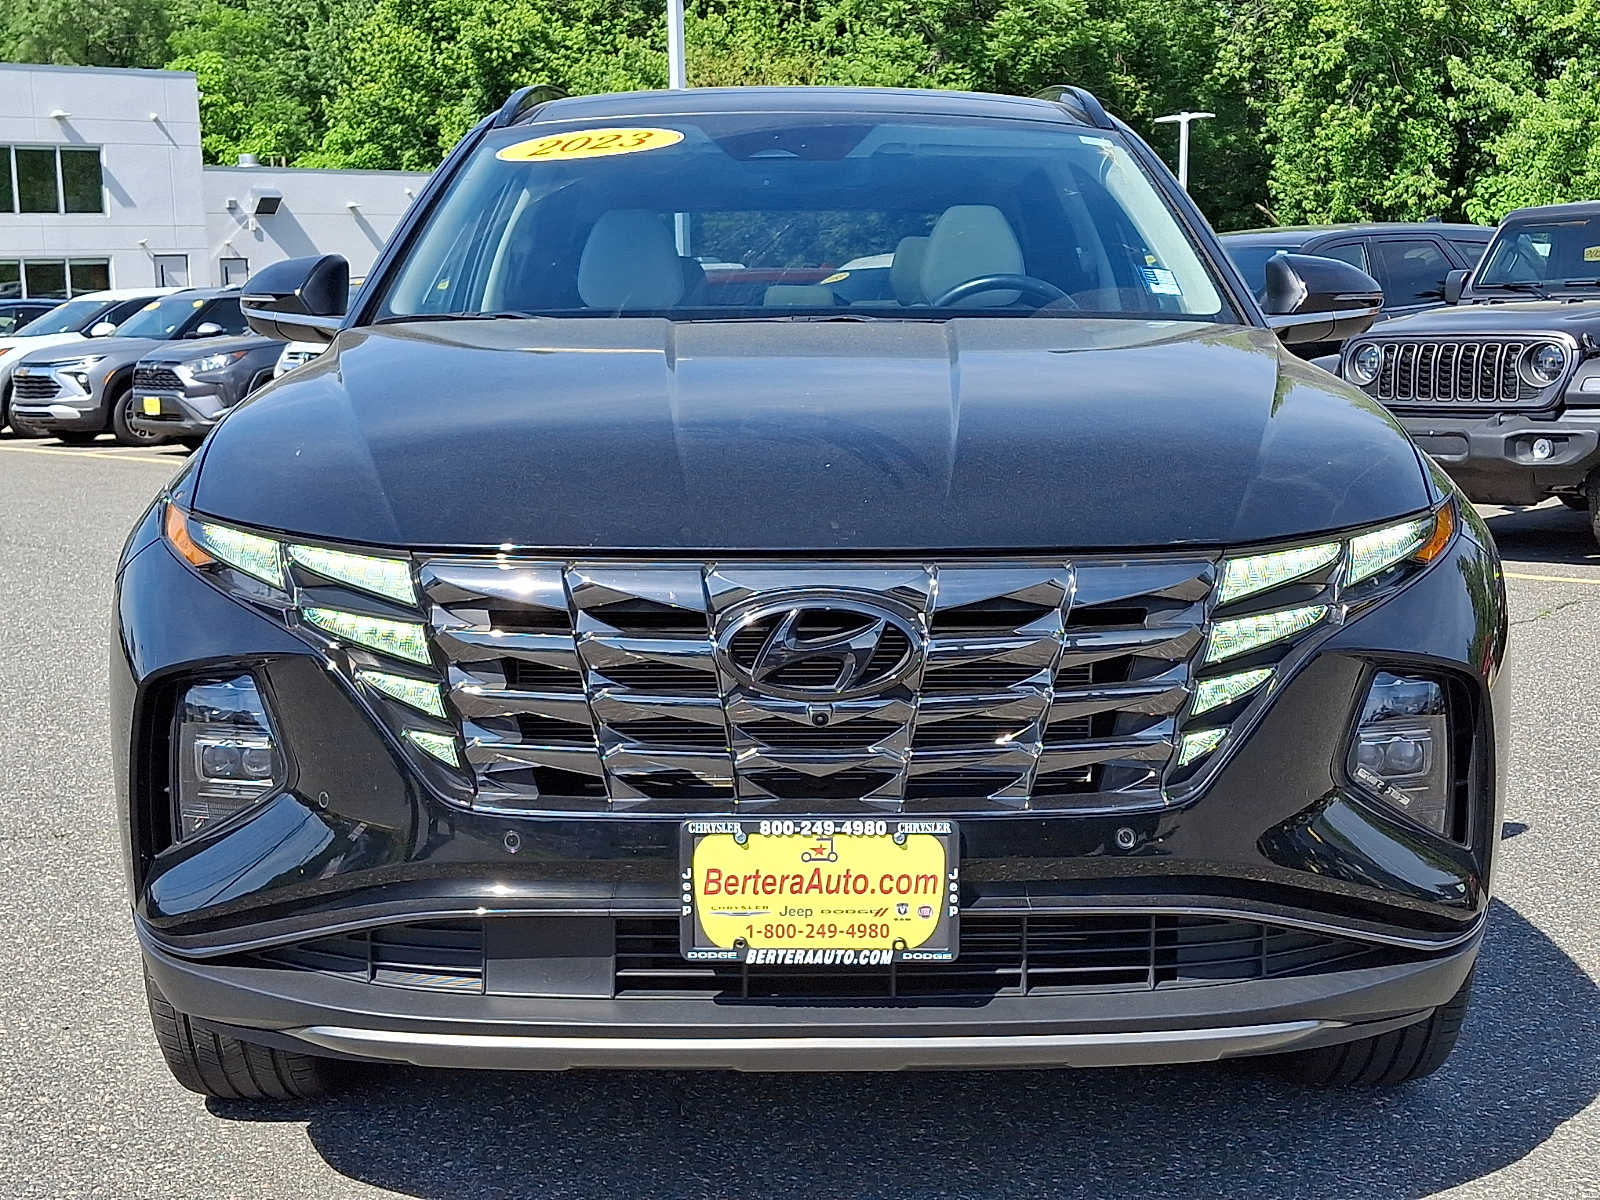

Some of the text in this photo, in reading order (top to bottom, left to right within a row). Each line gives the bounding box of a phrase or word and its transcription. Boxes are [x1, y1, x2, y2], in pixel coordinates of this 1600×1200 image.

[527, 131, 654, 157] 2023
[688, 822, 741, 834] CHRYSLER
[759, 820, 887, 836] 800-249-4980
[897, 822, 951, 834] CHRYSLER
[703, 867, 938, 895] BerteraAuto.com
[681, 868, 692, 917] Jeep
[948, 868, 959, 917] Jeep
[779, 905, 813, 918] Jeep
[745, 923, 890, 939] 1-800-249-4980
[687, 951, 738, 959] DODGE
[745, 949, 893, 965] BERTERAAUTO.COM
[902, 952, 952, 960] DODGE
